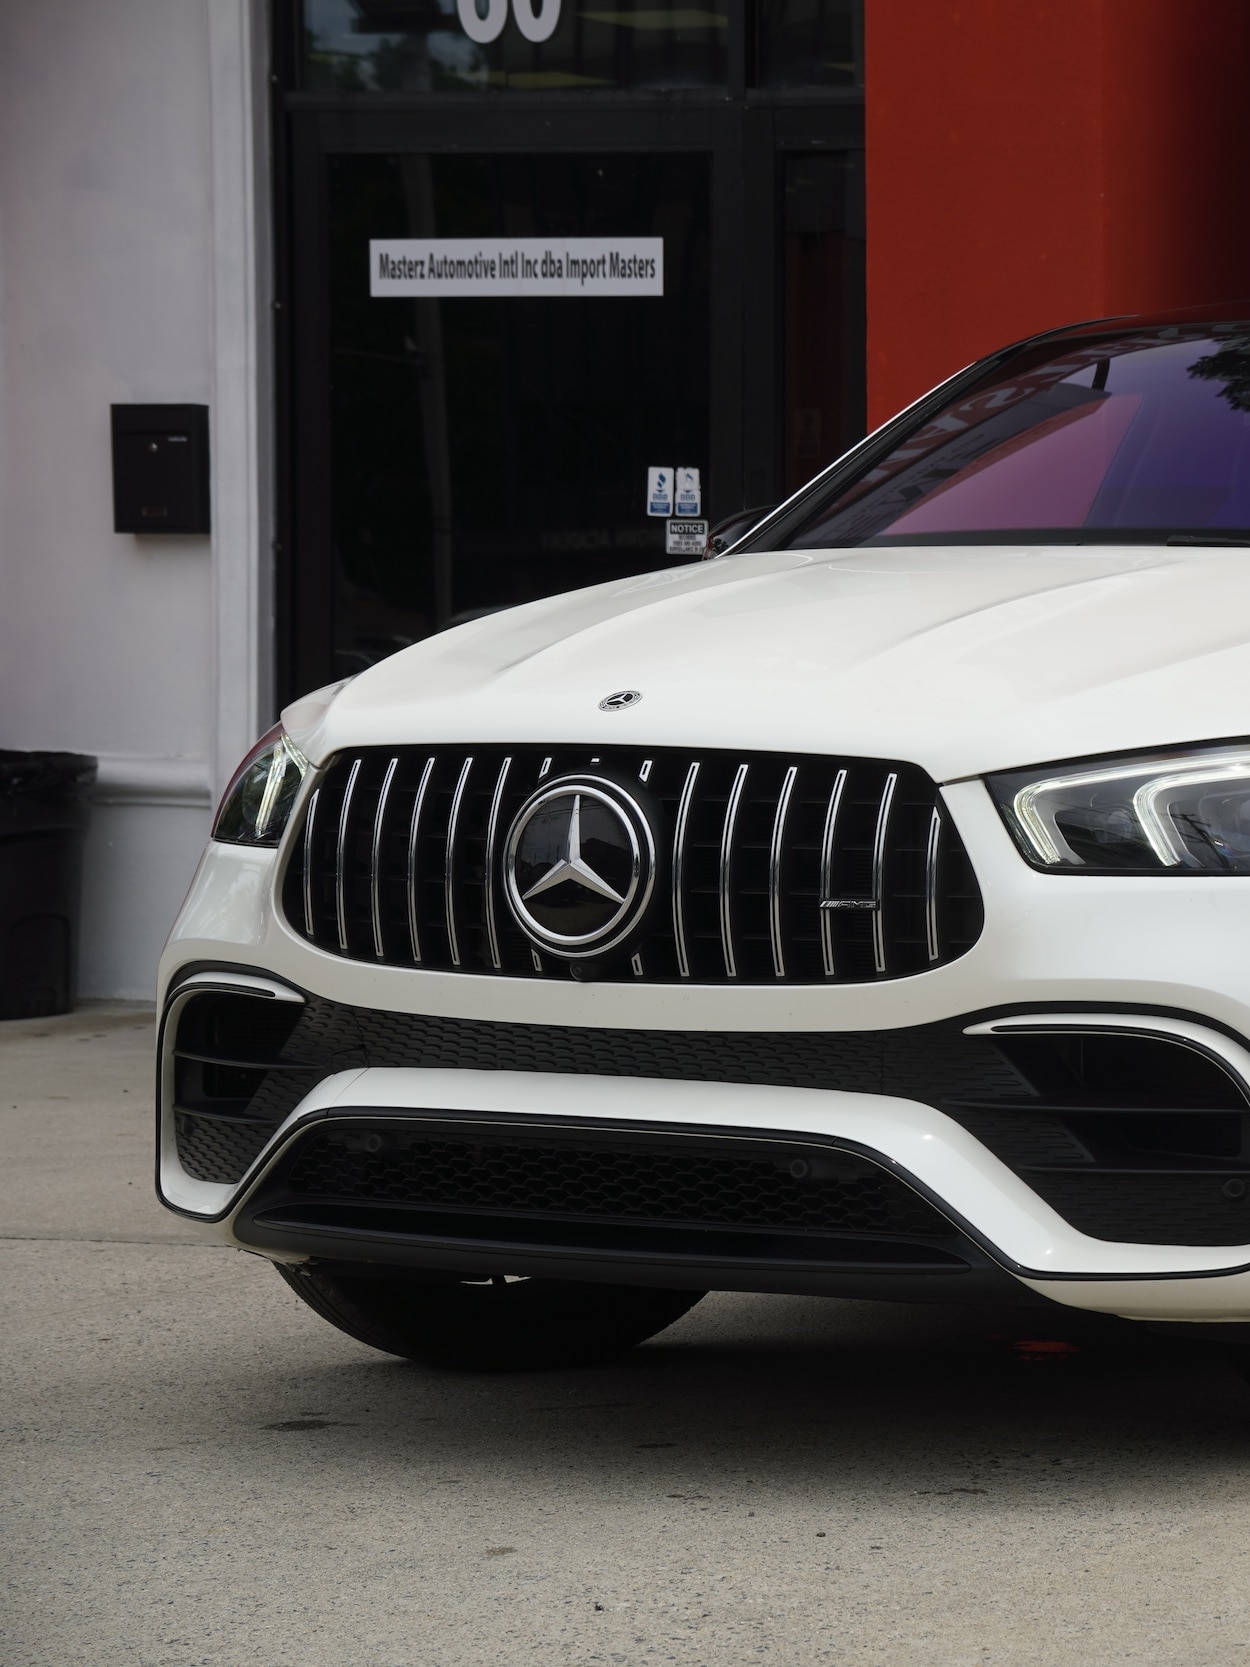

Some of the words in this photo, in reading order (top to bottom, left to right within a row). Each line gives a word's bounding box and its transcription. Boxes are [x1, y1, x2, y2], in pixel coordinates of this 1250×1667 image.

[379, 252, 425, 280] Masterz
[427, 251, 496, 280] Automotive
[499, 250, 518, 279] Intl
[521, 251, 538, 279] Inc
[541, 249, 563, 279] dba
[566, 251, 607, 287] Import
[609, 250, 656, 279] Masters
[671, 524, 704, 533] NOTICE
